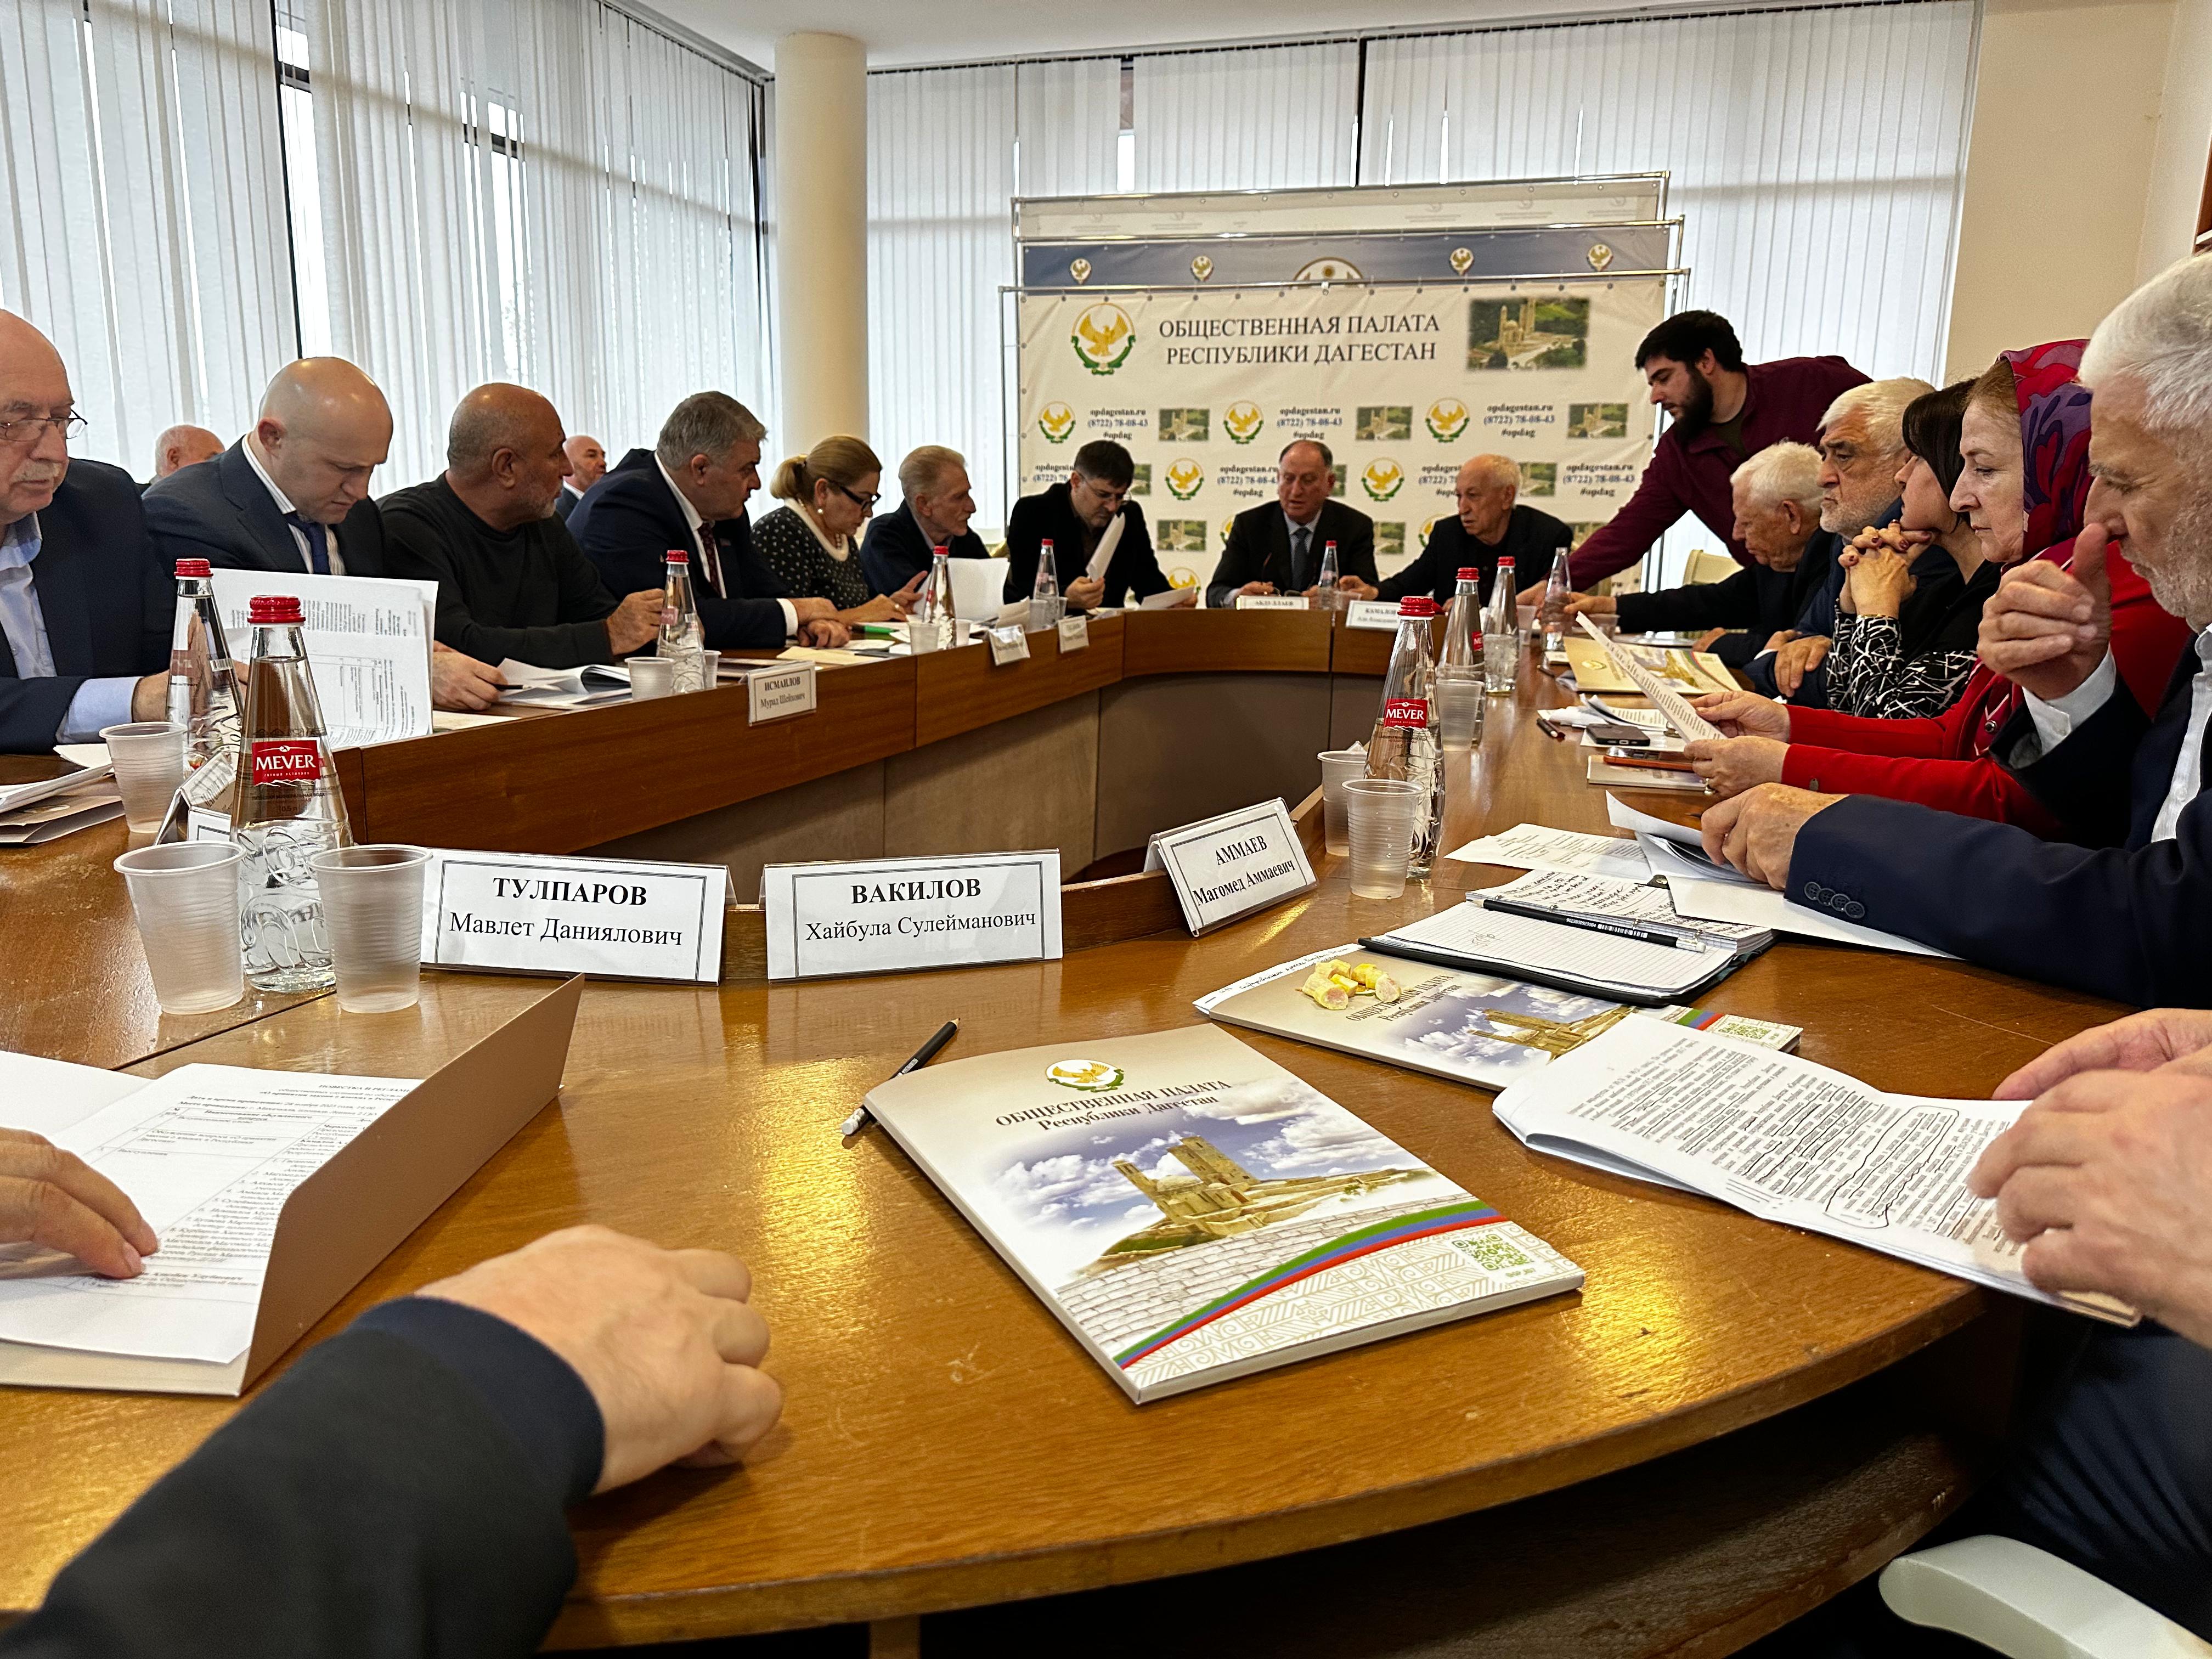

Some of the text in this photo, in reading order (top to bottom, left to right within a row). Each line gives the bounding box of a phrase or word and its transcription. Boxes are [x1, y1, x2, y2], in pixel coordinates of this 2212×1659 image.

[1159, 314, 1440, 341] ОБЩЕСТВЕННАЯ ПАЛАТА
[1167, 342, 1436, 365] РЕСПУБЛИКИ ДАГЕСТАН
[765, 676, 800, 691] ИСМАИЛОВ
[1385, 708, 1424, 720] MEVER
[256, 754, 317, 771] MEVER
[1215, 836, 1267, 866] АММАЕВ
[493, 878, 647, 906] ТУЛПАРОВ
[851, 878, 981, 904] ВАКИЛОВ
[1192, 860, 1295, 906] Магомед Аммаевич
[449, 912, 682, 946] Мавлет Даниялович
[805, 911, 1036, 941] Хайбула Сулейманович
[1415, 975, 1454, 994] ПАЛАТА
[1378, 984, 1462, 1022] Республики Дагестан
[995, 1080, 1233, 1127] ОБЩЕСТВЕННАЯ ПАЛАТА
[1037, 1096, 1220, 1130] Республики Дагестан
